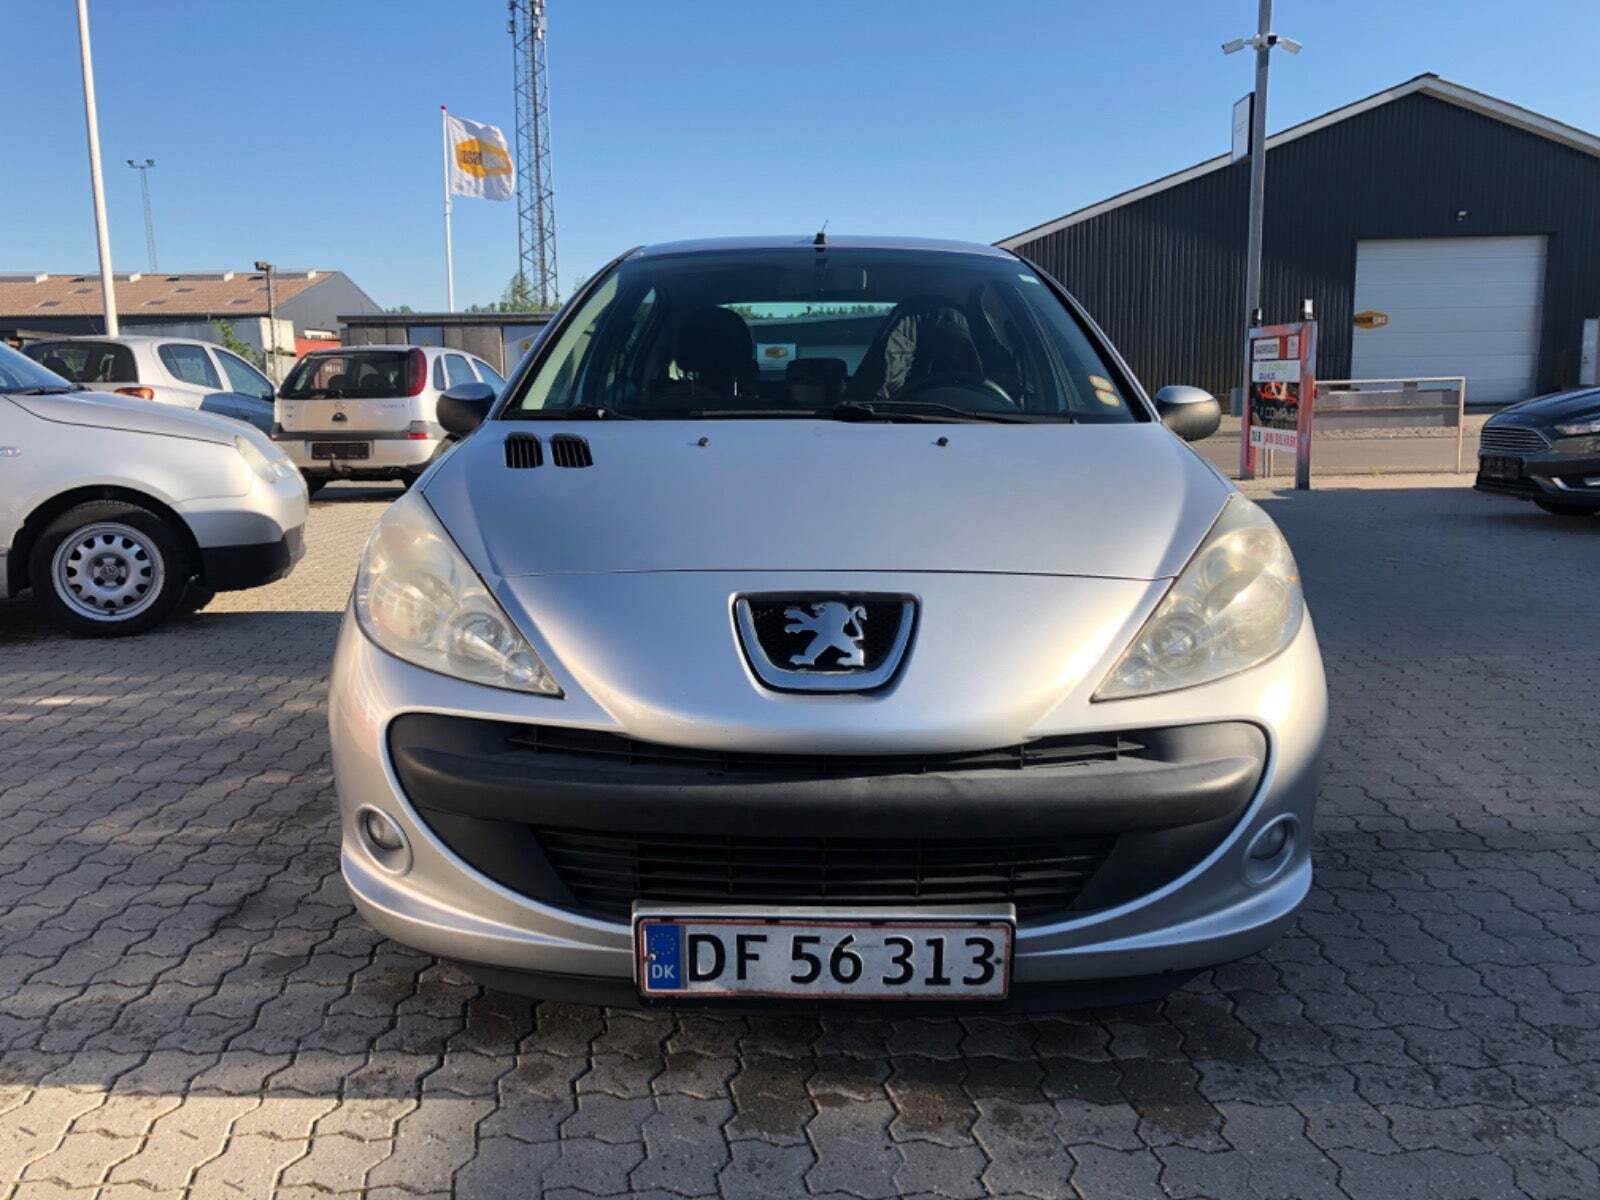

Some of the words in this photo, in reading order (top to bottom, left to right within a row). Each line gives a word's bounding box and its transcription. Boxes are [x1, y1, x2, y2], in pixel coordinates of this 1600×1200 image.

[651, 964, 675, 979] DK
[687, 933, 767, 983] DF
[789, 934, 863, 985] 56
[882, 936, 996, 987] 313
